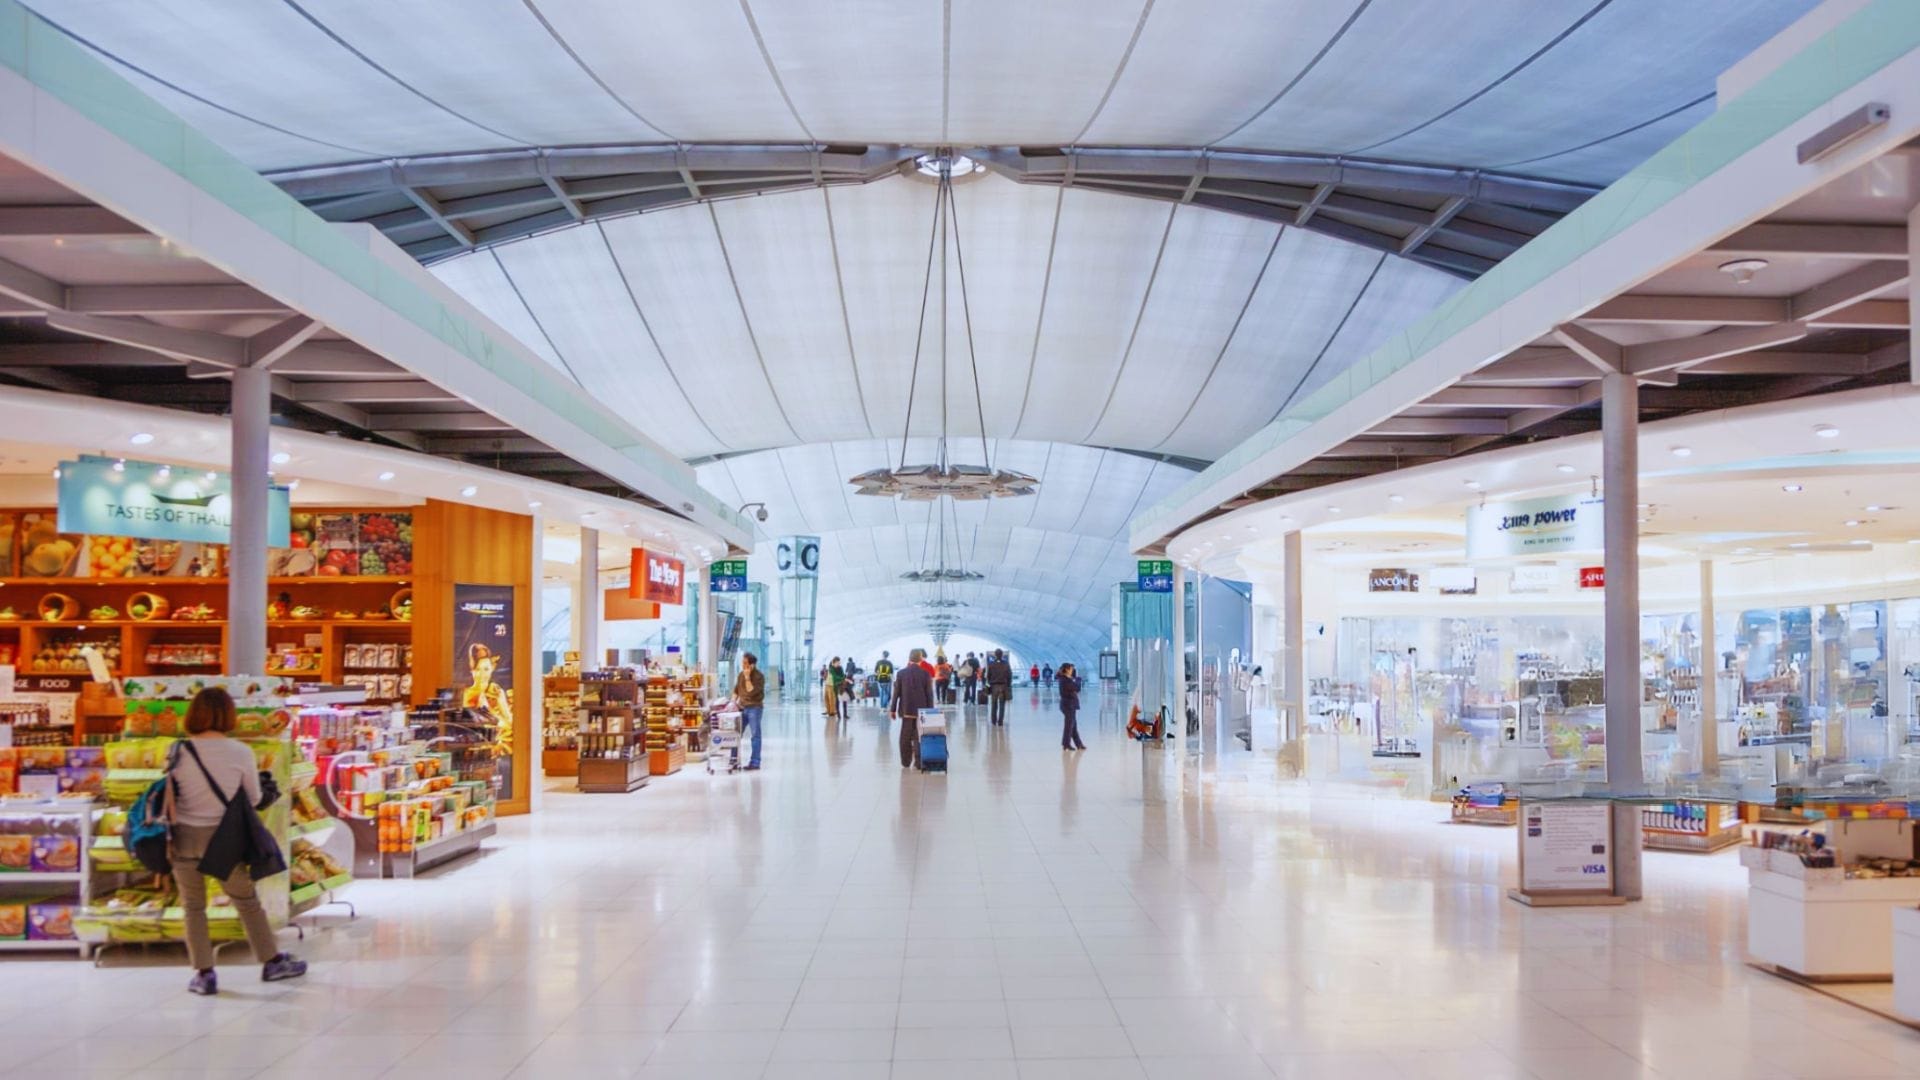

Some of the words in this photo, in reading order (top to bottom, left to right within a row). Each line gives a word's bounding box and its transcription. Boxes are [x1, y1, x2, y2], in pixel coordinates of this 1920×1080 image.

[106, 504, 160, 521] TASTES
[163, 508, 184, 522] OF
[188, 511, 231, 527] THAIL
[777, 543, 792, 571] C
[801, 543, 819, 571] C
[1582, 864, 1607, 875] VISA
